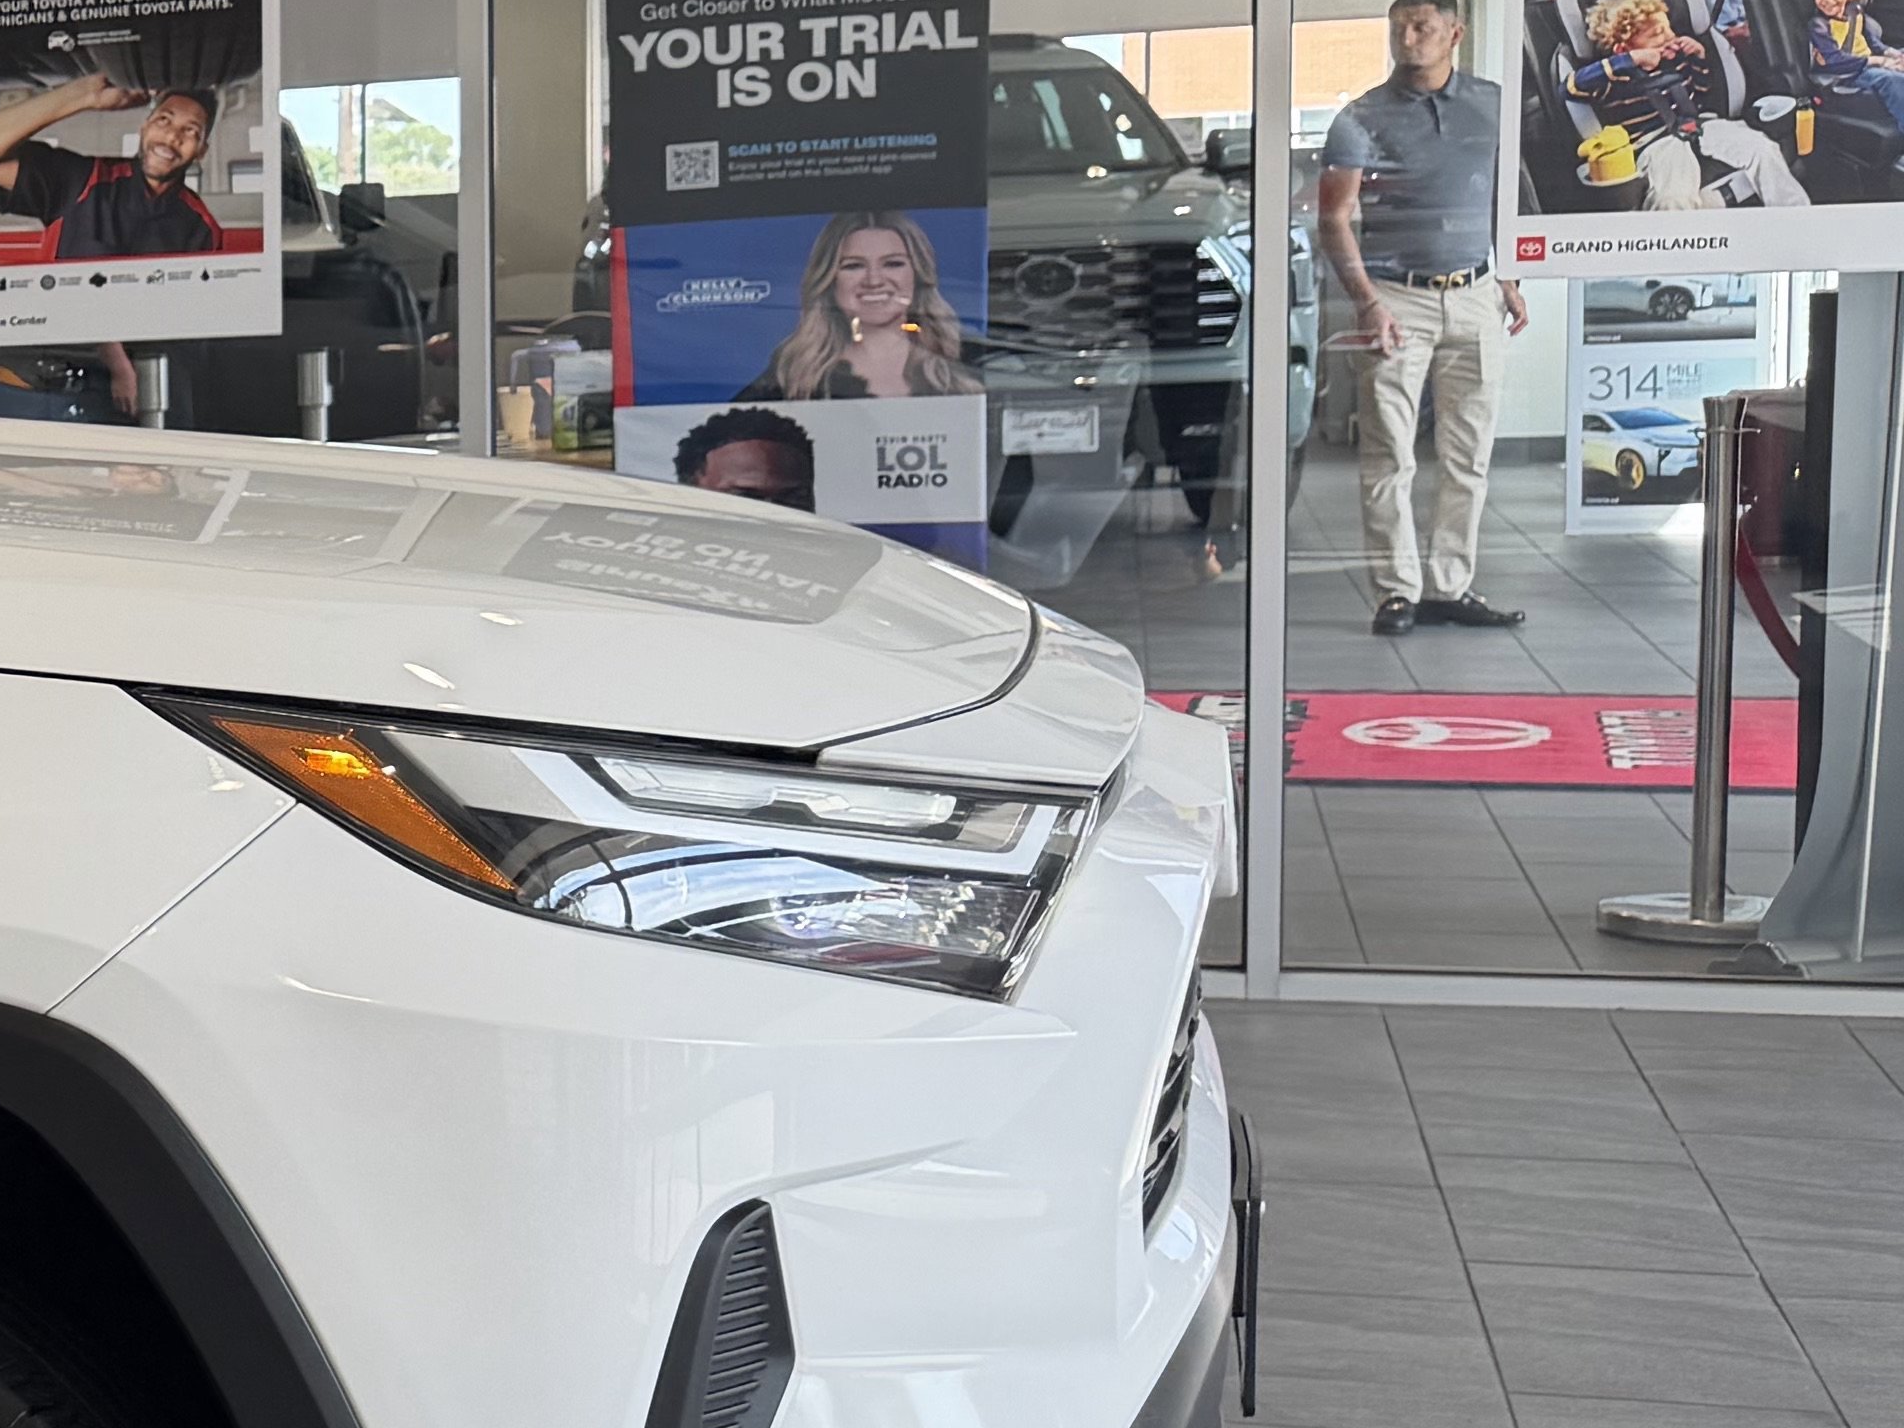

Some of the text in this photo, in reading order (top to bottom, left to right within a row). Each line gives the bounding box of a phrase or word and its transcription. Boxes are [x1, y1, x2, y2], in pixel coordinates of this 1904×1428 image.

[57, 10, 67, 22] &
[70, 4, 130, 21] GENUINE
[134, 0, 185, 15] TOYOTA
[640, 2, 678, 22] Get
[619, 9, 979, 73] YOUR TRIAL
[716, 57, 878, 108] IS ON
[728, 133, 937, 158] SCAN TO START LISTENING
[1552, 237, 1729, 254] GRAND HIGHLANDER
[10, 315, 47, 327] Center
[1588, 364, 1663, 401] 314
[877, 445, 947, 471] LOL
[878, 473, 947, 488] RADIO
